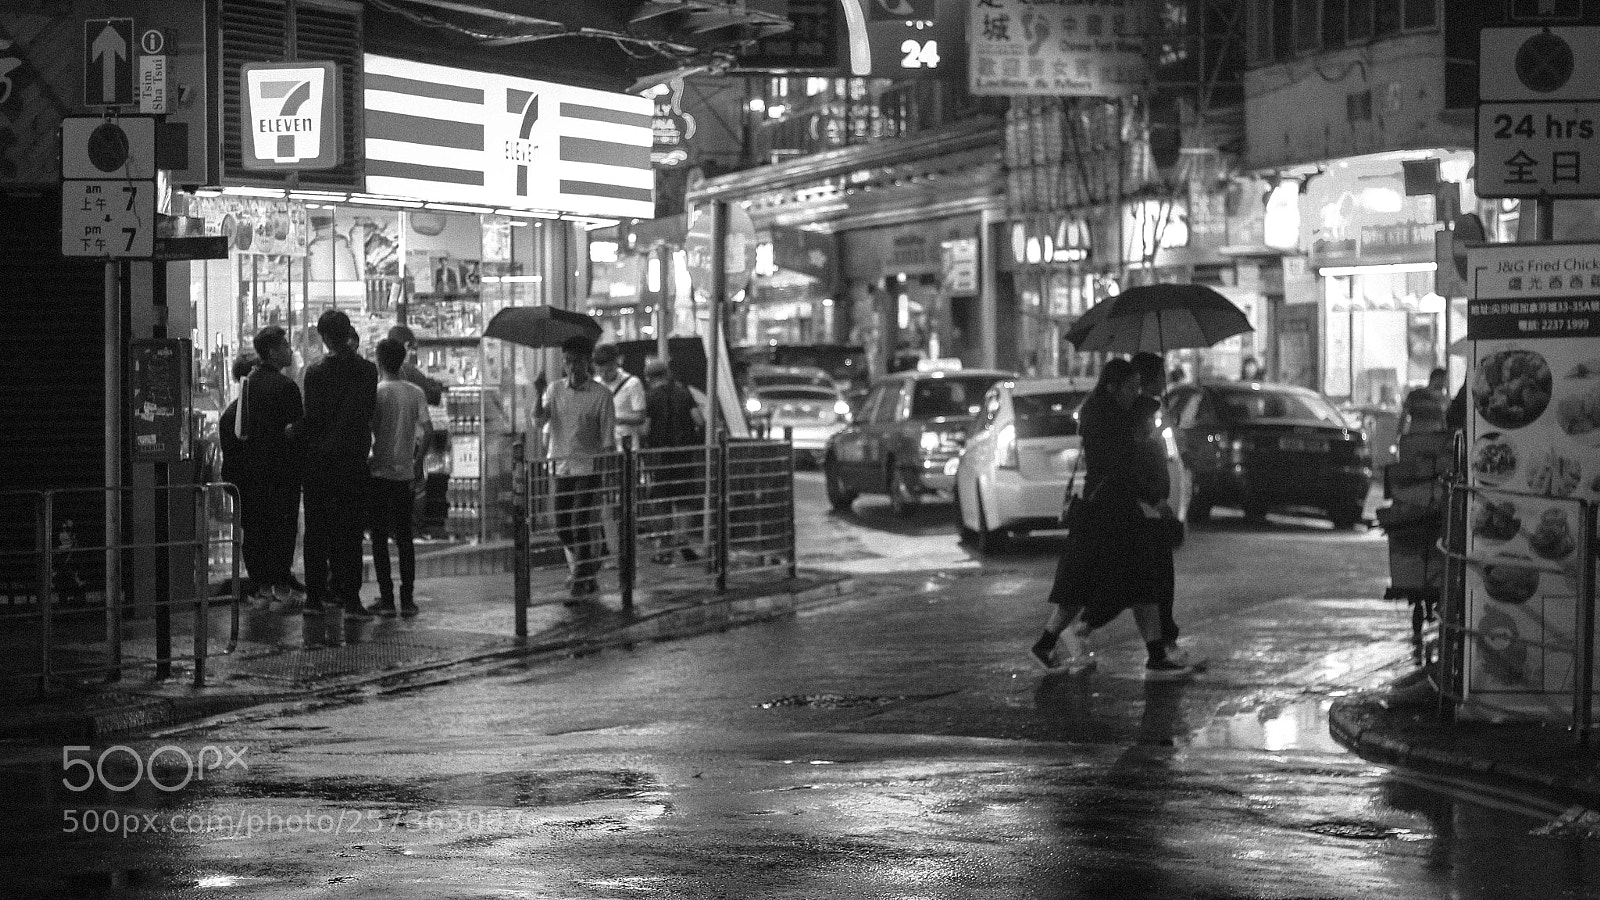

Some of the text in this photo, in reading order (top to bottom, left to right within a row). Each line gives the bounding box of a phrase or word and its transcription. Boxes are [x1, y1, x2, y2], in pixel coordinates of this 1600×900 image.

[901, 40, 940, 68] 24
[142, 70, 153, 100] Tsim
[152, 59, 163, 111] Sha Tsui
[259, 80, 311, 157] 7
[1494, 113, 1595, 139] 24 hrs
[1503, 149, 1580, 184] 全日
[85, 185, 101, 194] am
[122, 186, 138, 211] 7
[80, 197, 106, 211] 上午
[85, 226, 101, 236] pm
[121, 227, 137, 252] 7
[80, 238, 106, 252] 下午
[1497, 260, 1524, 273] J&G
[1528, 259, 1560, 272] Fried
